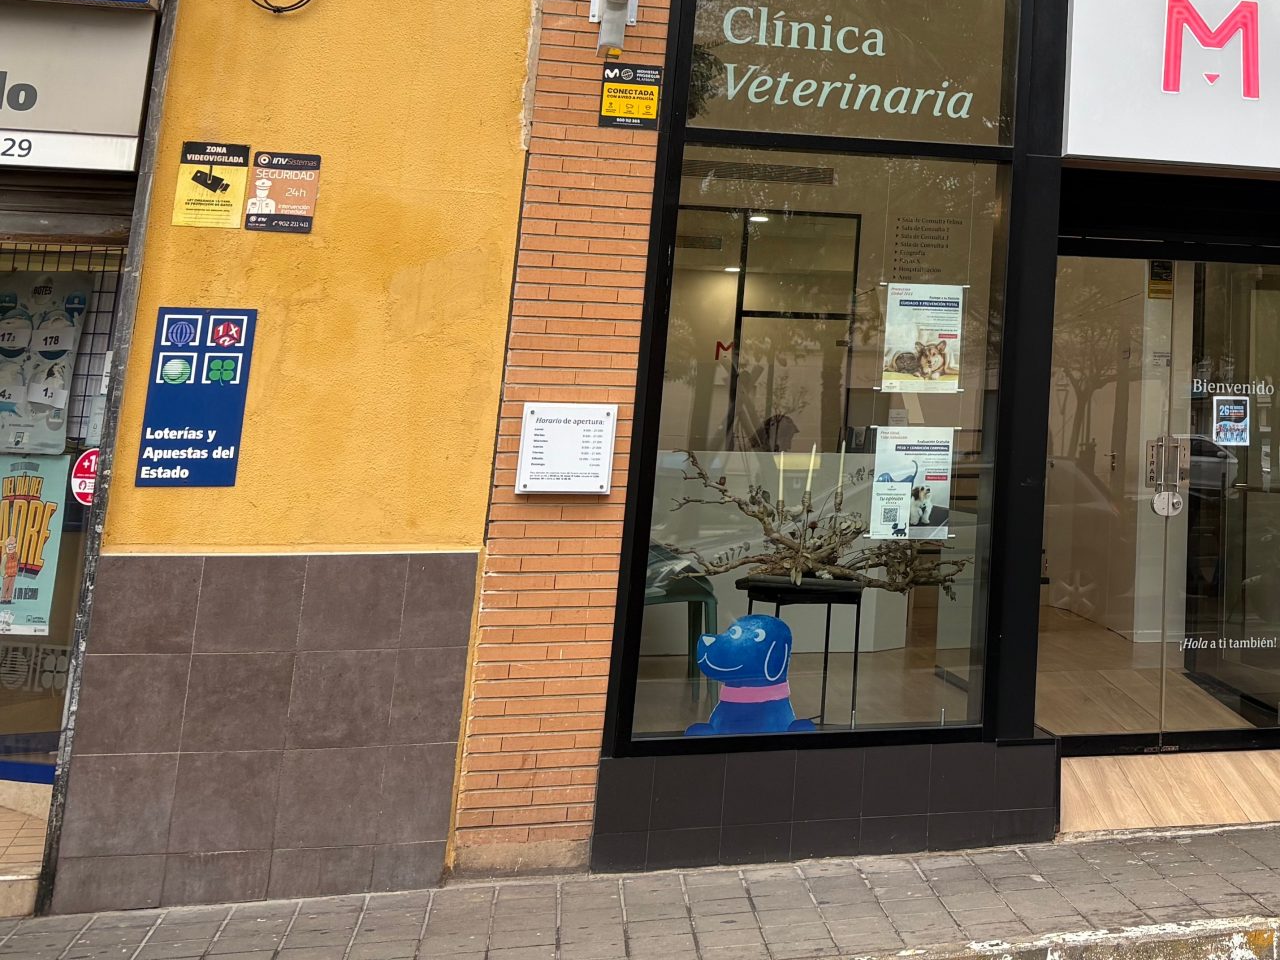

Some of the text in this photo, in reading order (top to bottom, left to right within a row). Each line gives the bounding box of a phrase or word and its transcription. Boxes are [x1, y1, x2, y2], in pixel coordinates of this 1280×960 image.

[723, 5, 886, 57] Clínica
[607, 88, 655, 97] CONECTADA
[723, 63, 974, 119] Veterinaria
[0, 138, 32, 158] 29
[206, 145, 227, 153] ZONA
[186, 153, 244, 164] VIDEOVIGILADA
[255, 169, 315, 181] SEGURIDAD
[285, 187, 307, 197] 24h
[42, 335, 60, 346] 178
[1193, 378, 1274, 395] Bienvenido
[1220, 405, 1230, 415] 26
[145, 427, 216, 442] Loterías y
[143, 446, 235, 461] Apuestas del
[140, 466, 189, 478] Estado
[1179, 636, 1277, 652] ¡Hola a ti también!
